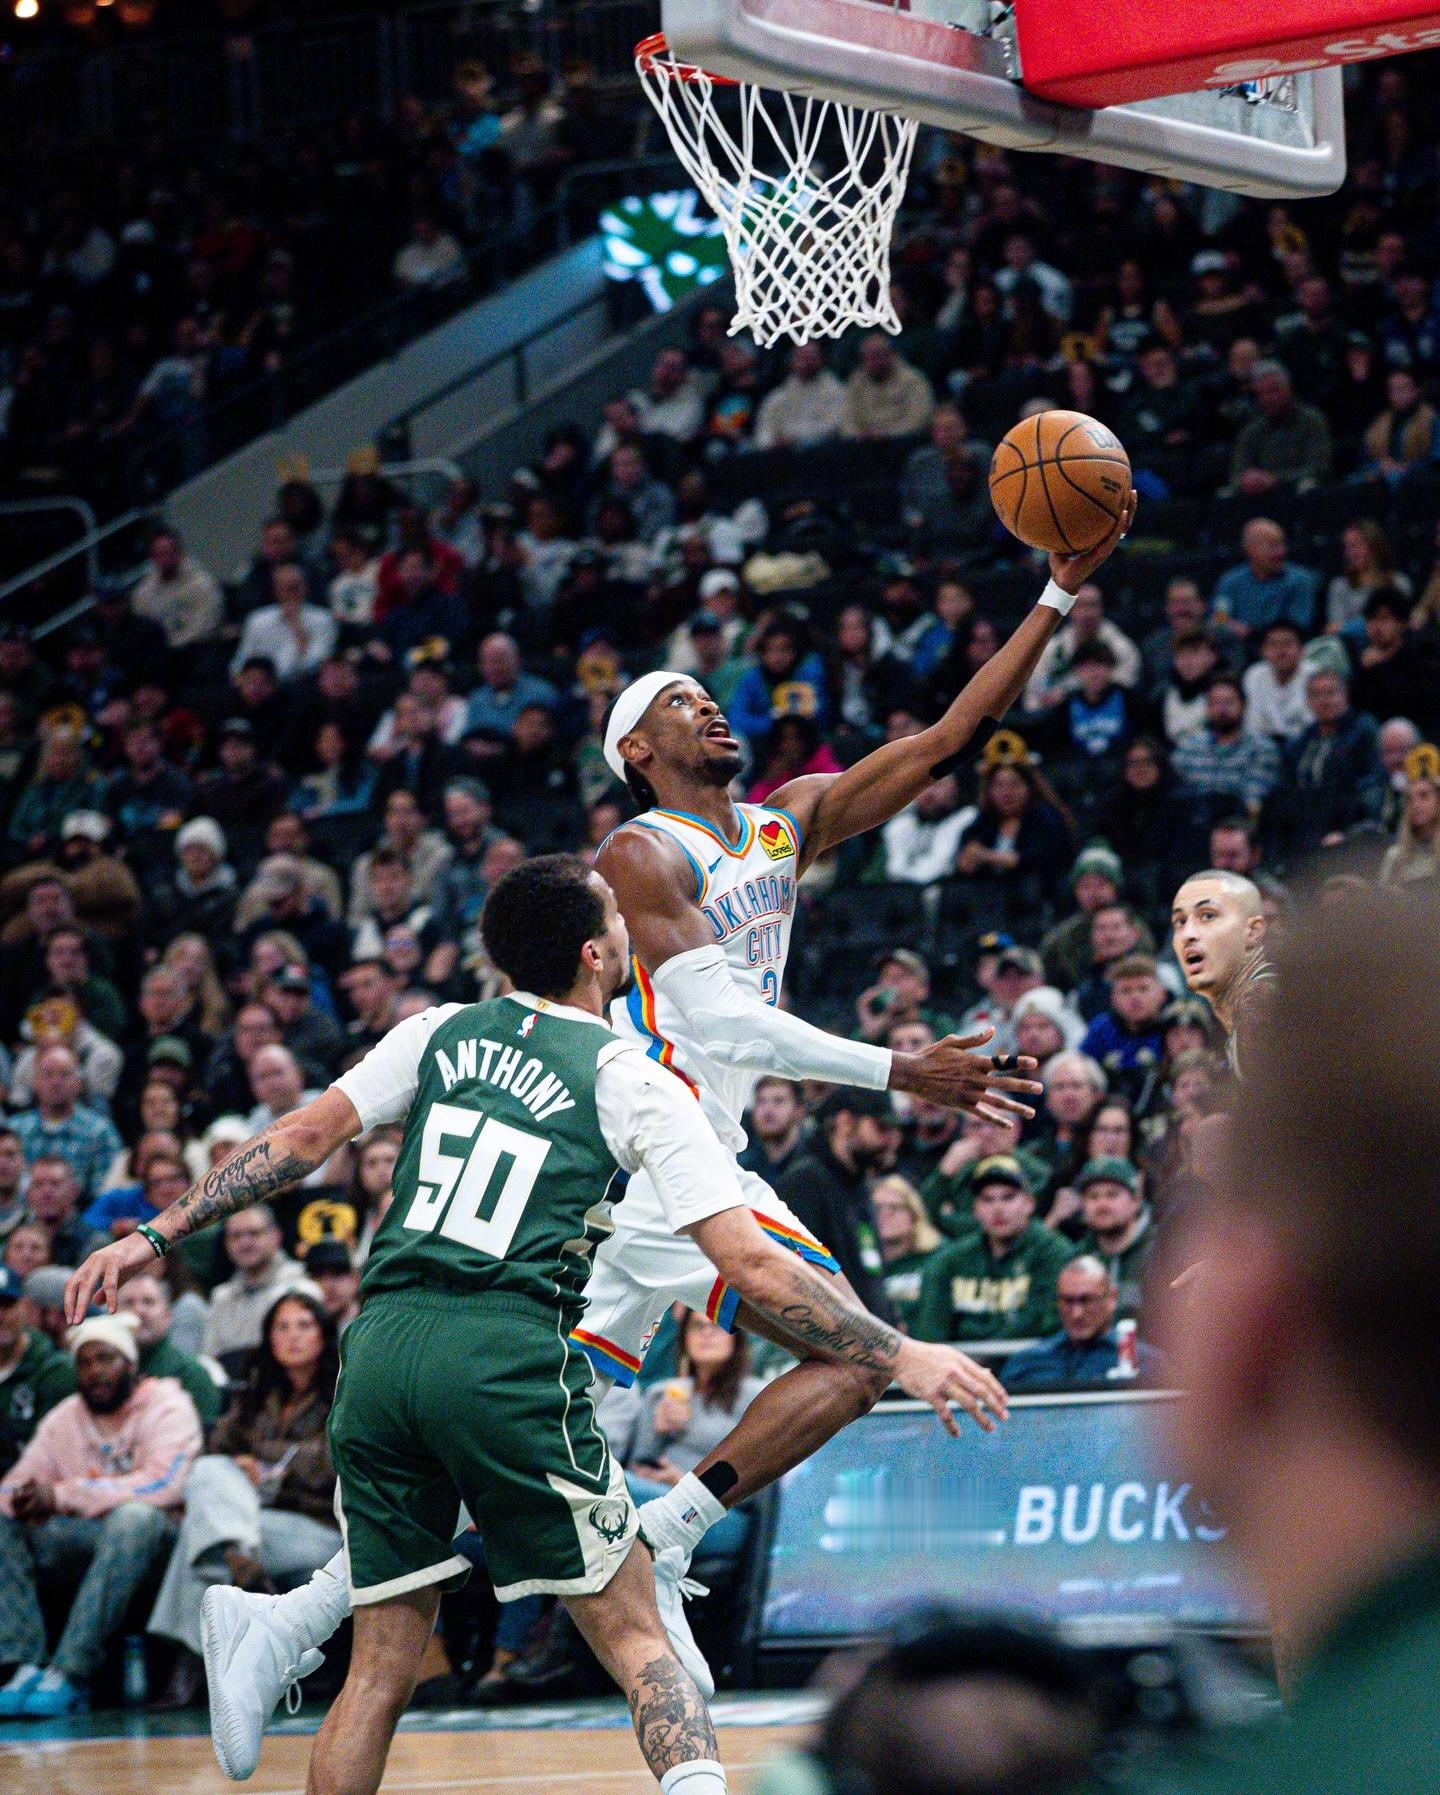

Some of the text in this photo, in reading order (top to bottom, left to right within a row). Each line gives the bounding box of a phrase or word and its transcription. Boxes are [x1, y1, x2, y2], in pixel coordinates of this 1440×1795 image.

[701, 875, 796, 942] OKLAHOM
[746, 920, 782, 967] CITY
[760, 966, 778, 1008] 2
[434, 1038, 576, 1122] ANTHONY
[203, 1141, 271, 1198] Gregory
[402, 1102, 553, 1261] 50
